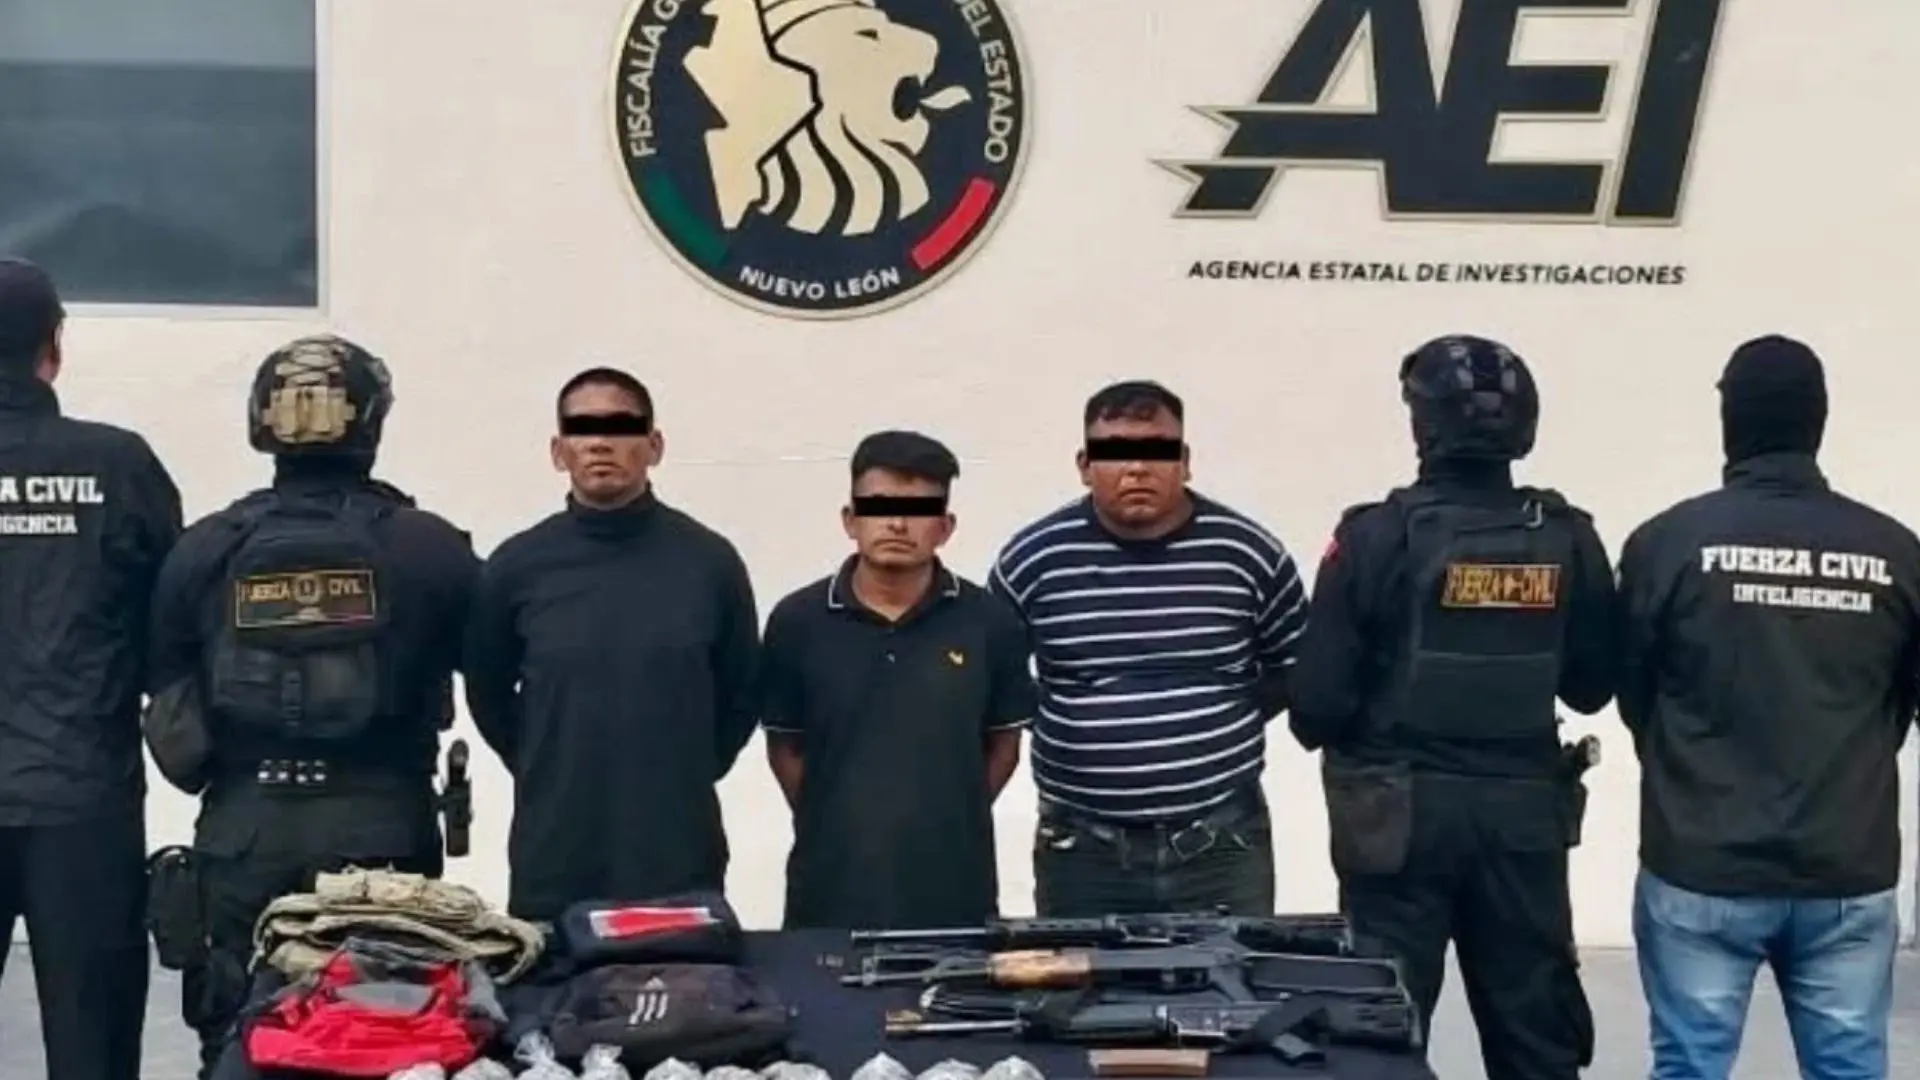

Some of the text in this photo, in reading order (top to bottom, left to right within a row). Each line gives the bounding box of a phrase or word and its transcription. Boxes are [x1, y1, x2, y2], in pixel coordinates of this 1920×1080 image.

[626, 24, 668, 158] FISCALÍA
[979, 39, 1014, 163] ESTADO
[1149, 0, 1732, 227] AEI
[739, 265, 900, 301] NUEVO LEÓN
[1188, 260, 1687, 286] AGENCIA ESTATAL DE INVESTIGACIONES
[25, 475, 105, 504] CIVIL
[1701, 545, 1894, 586] FUERZA CIVIL
[1732, 582, 1874, 614] INTELIGENCIA
